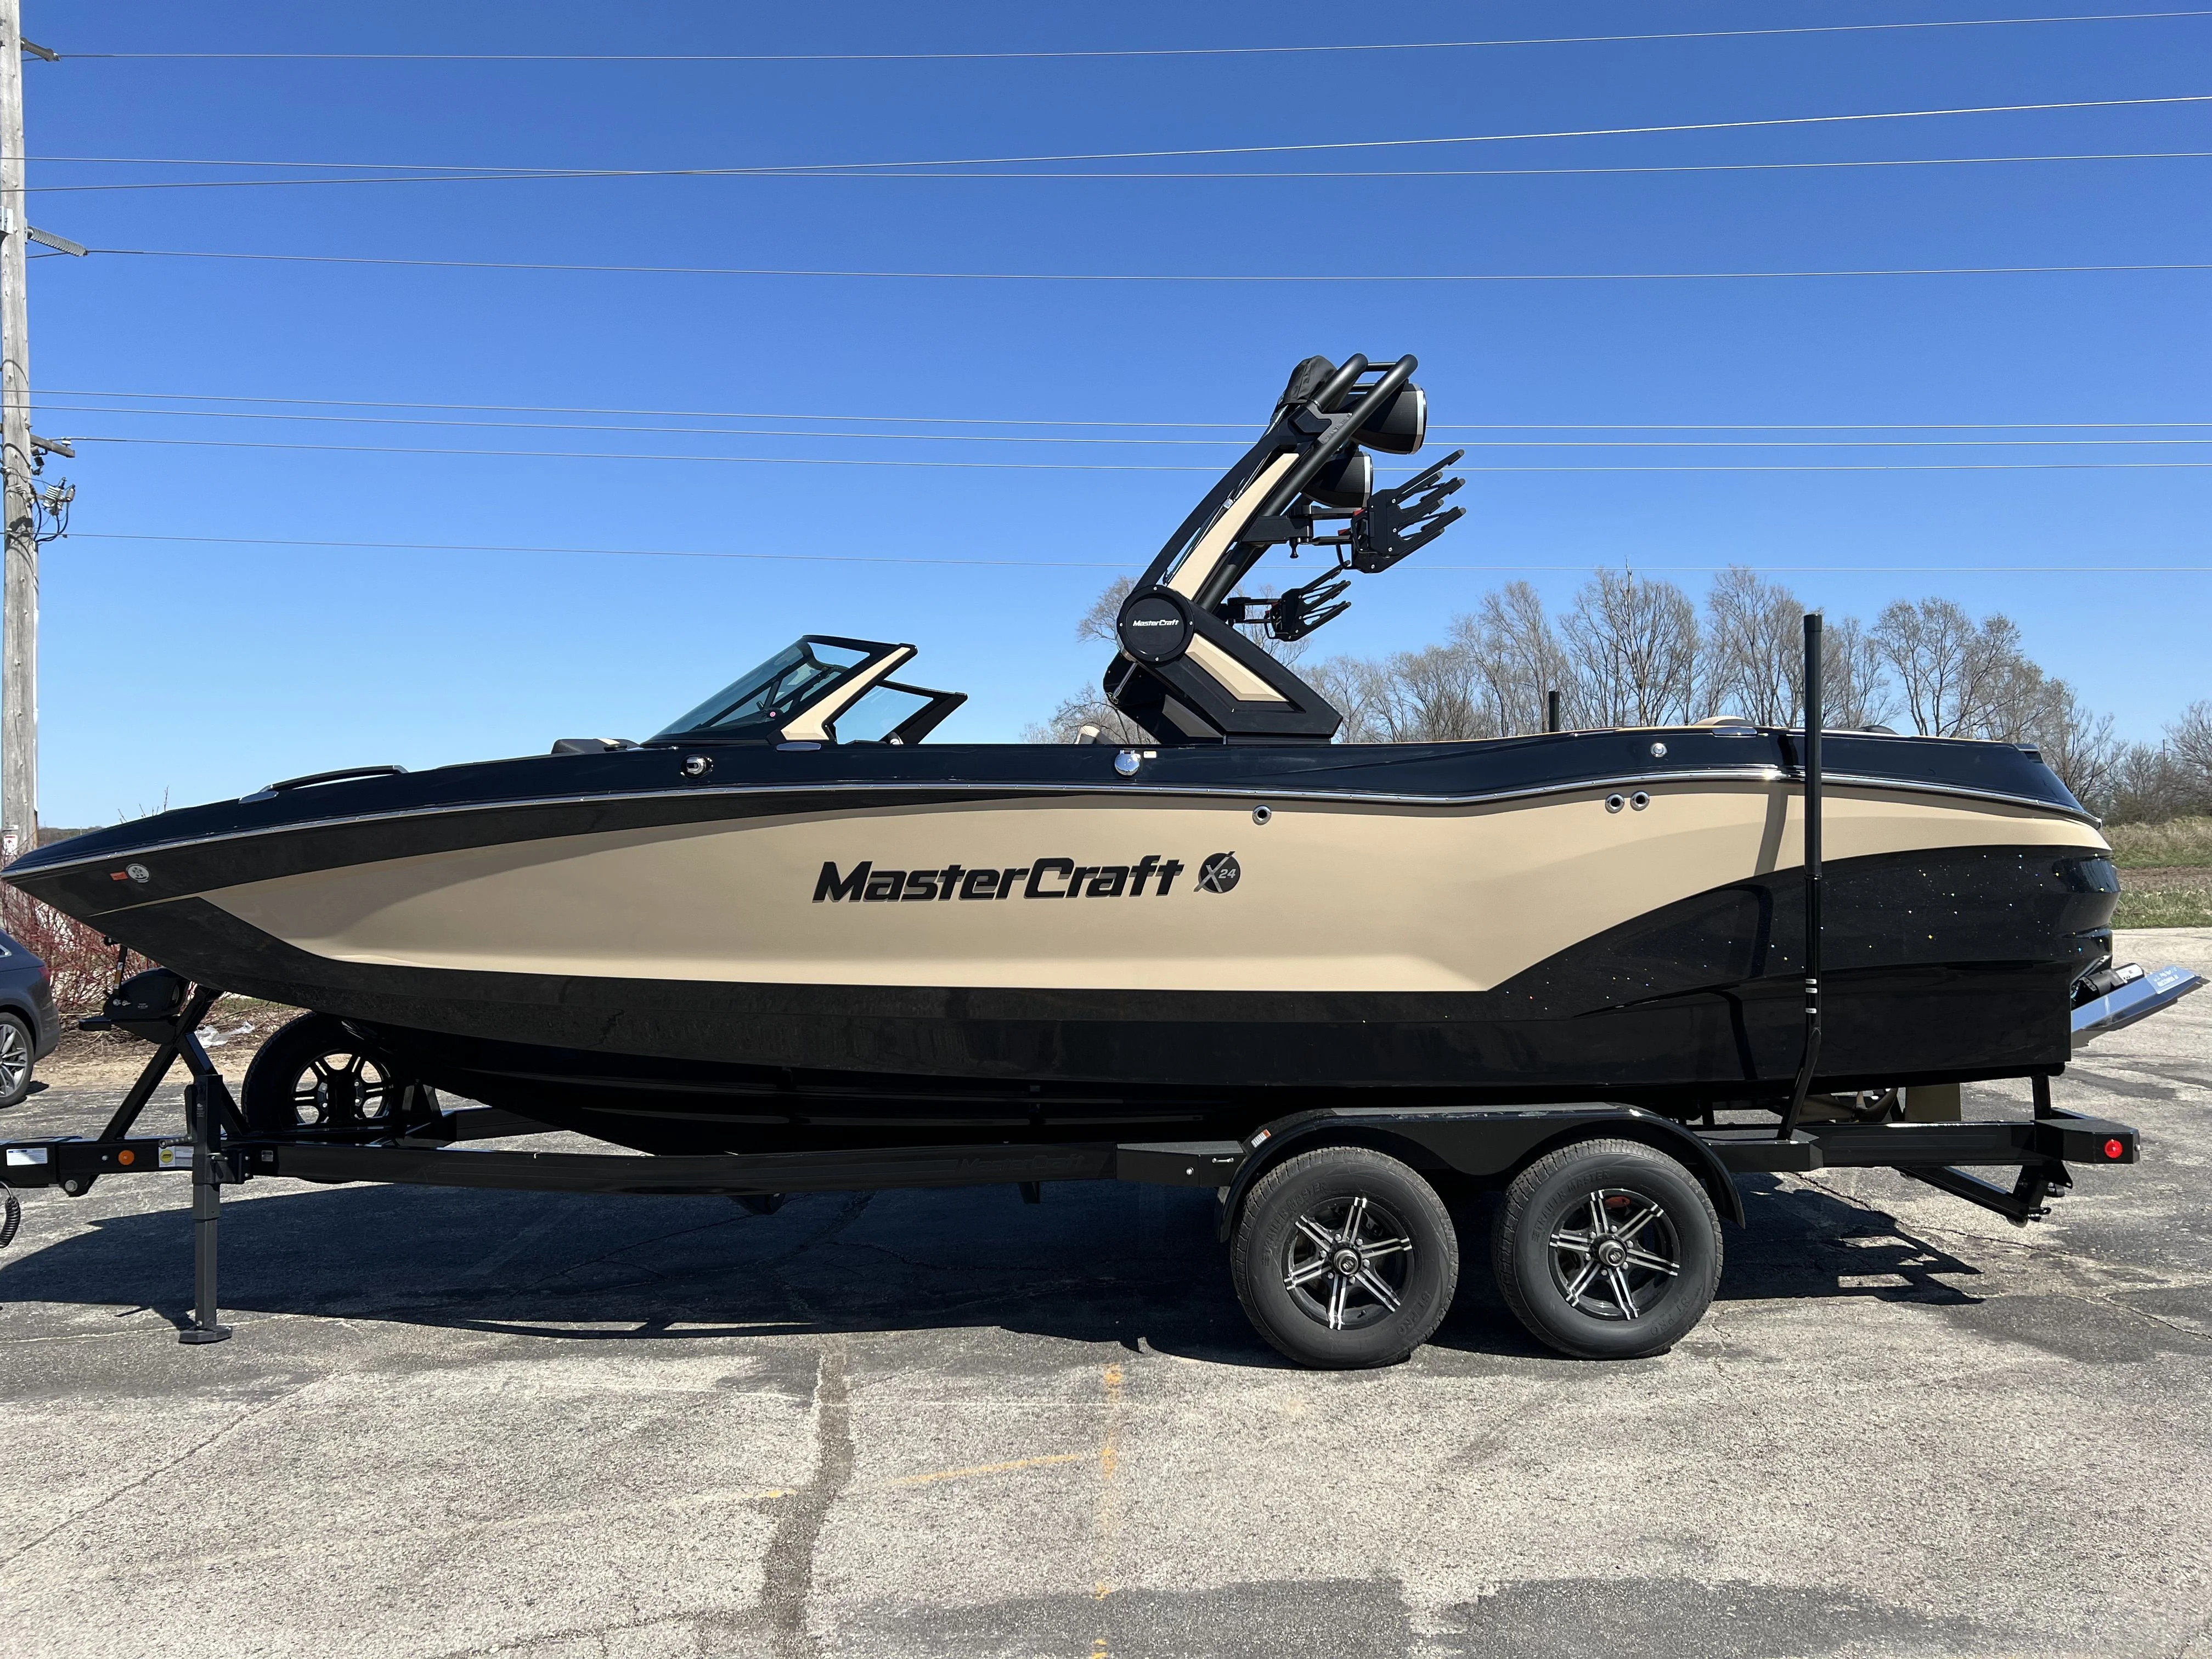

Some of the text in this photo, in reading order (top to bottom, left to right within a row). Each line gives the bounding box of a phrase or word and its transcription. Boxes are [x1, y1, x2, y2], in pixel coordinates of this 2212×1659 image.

[811, 854, 1185, 904] MasterCraft
[957, 1155, 1085, 1174] MasterCraft
[1566, 1169, 1610, 1192] MASTER
